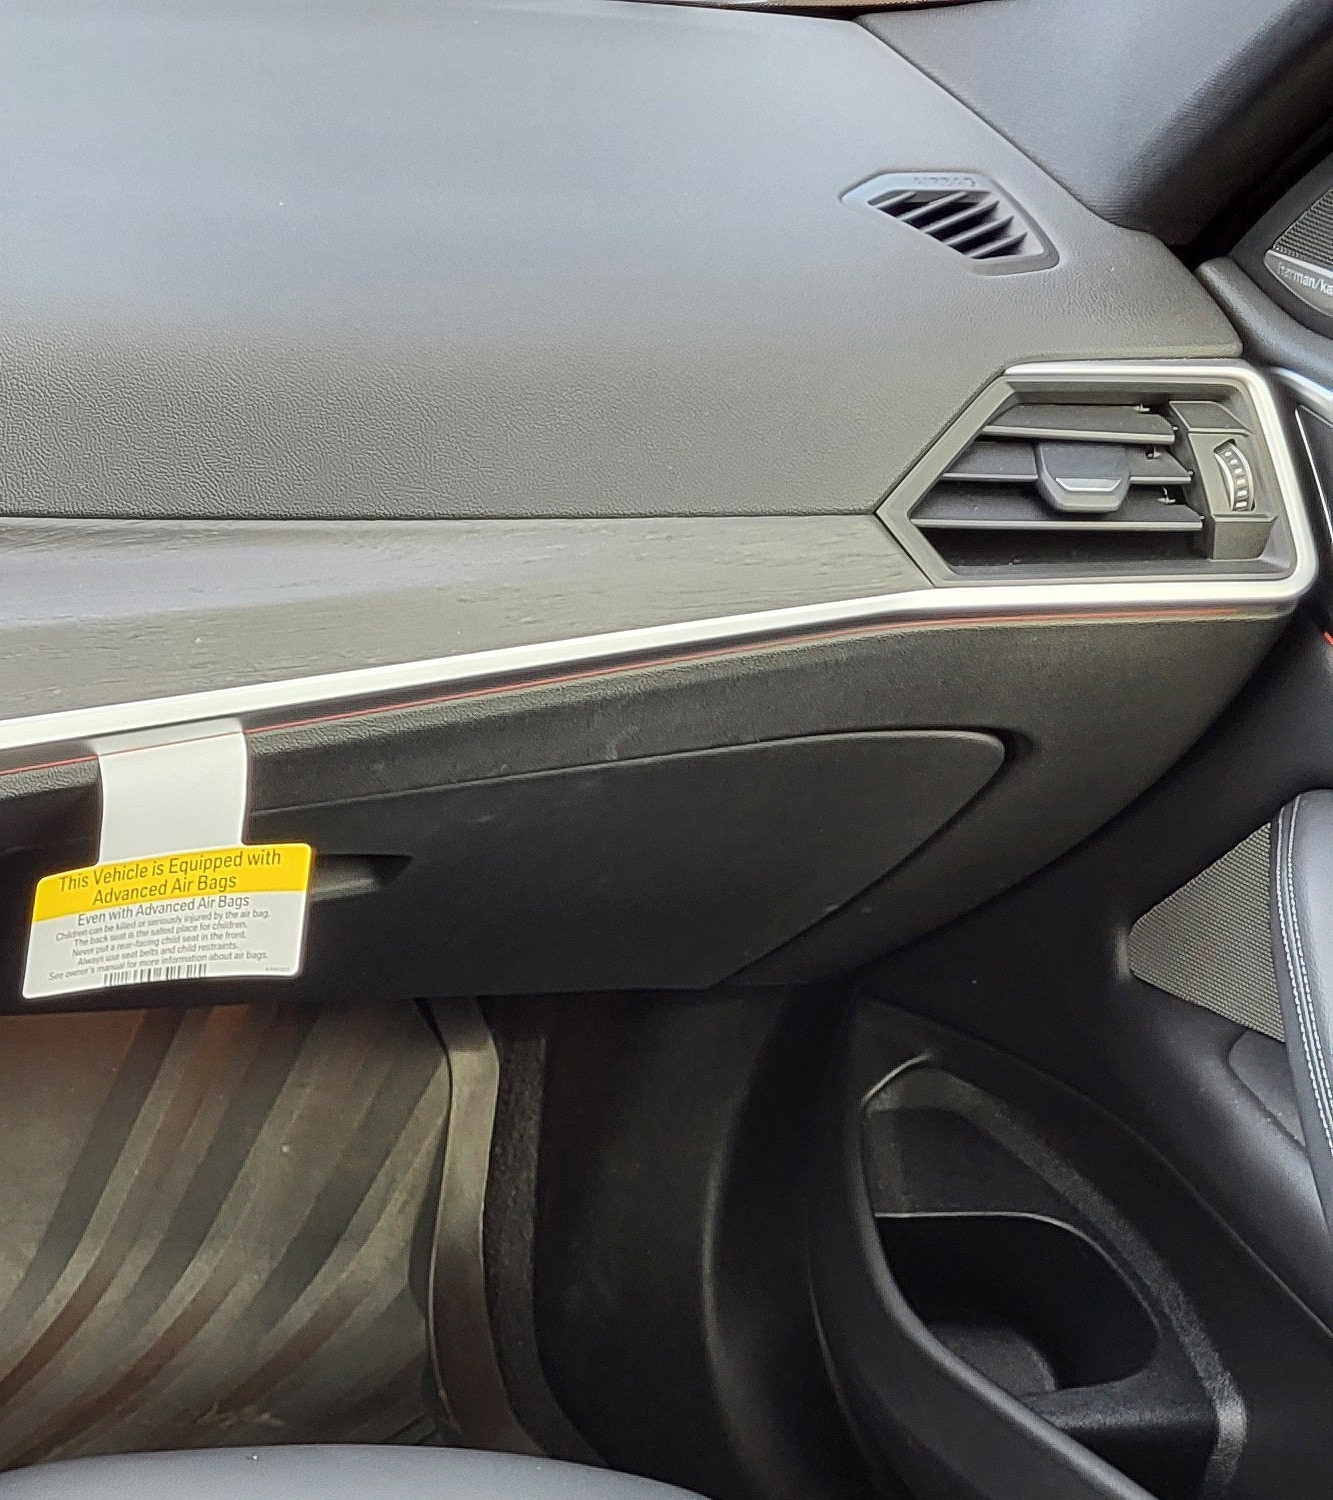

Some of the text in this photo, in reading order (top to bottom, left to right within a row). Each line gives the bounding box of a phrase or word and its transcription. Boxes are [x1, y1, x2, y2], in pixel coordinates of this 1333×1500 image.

[59, 849, 281, 892] This Vehicle is Equipped with
[93, 875, 237, 905] Advanced Air Bags
[56, 909, 270, 941] Children can be killed or seriously injured by the air bag.
[77, 895, 250, 926] Even with Advanced Air Bags
[74, 938, 88, 947] The
[90, 935, 108, 945] back
[110, 932, 126, 942] seat
[136, 929, 149, 937] the
[151, 926, 174, 936] safest
[176, 924, 198, 934] place
[199, 923, 211, 932] for
[213, 921, 248, 931] children.
[95, 945, 109, 954] put
[116, 938, 159, 951] rear-facing
[161, 935, 180, 945] child
[182, 934, 199, 943] seat
[201, 933, 208, 941] in
[210, 932, 223, 940] the
[225, 931, 246, 940] front.
[49, 972, 64, 981] See
[97, 962, 125, 973] manual
[127, 960, 137, 968] for
[139, 958, 159, 967] more
[161, 952, 207, 964] information
[209, 950, 232, 961] about
[234, 951, 244, 960] air
[77, 955, 105, 966] Always
[121, 950, 138, 960] seat
[139, 947, 158, 957] belts
[161, 946, 175, 955] and
[177, 943, 197, 953] child
